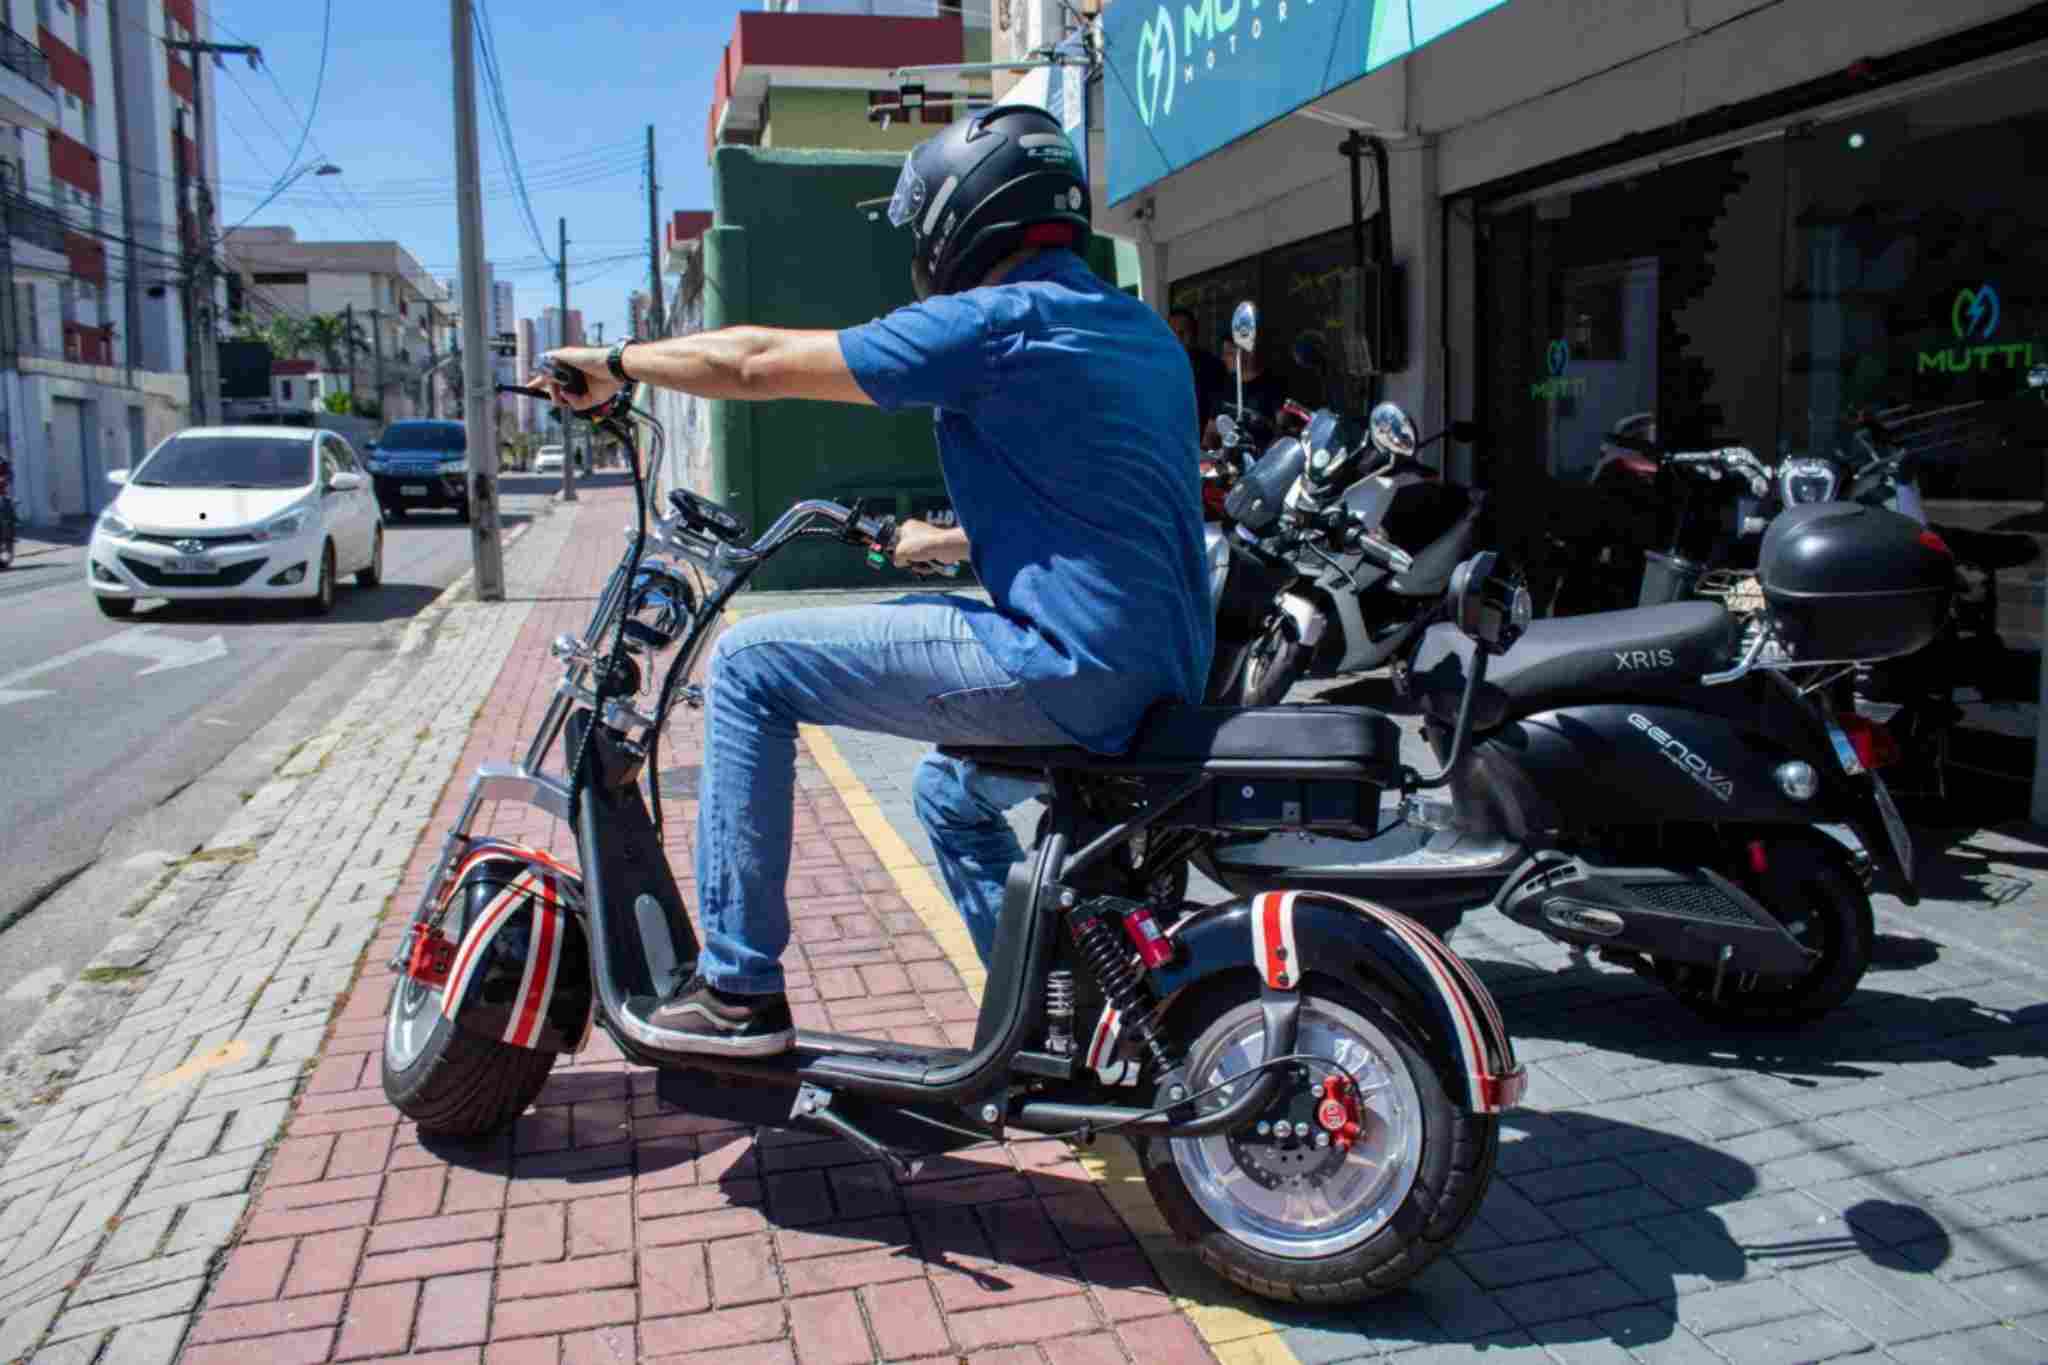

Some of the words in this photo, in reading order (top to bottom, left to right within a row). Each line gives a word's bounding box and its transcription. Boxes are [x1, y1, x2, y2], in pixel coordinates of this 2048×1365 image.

[1184, 0, 1260, 56] MU
[1184, 0, 1314, 84] MOTOR
[1917, 343, 2033, 374] MUTTI
[1615, 648, 1674, 670] XRIS
[1627, 712, 1734, 796] GENOVA
